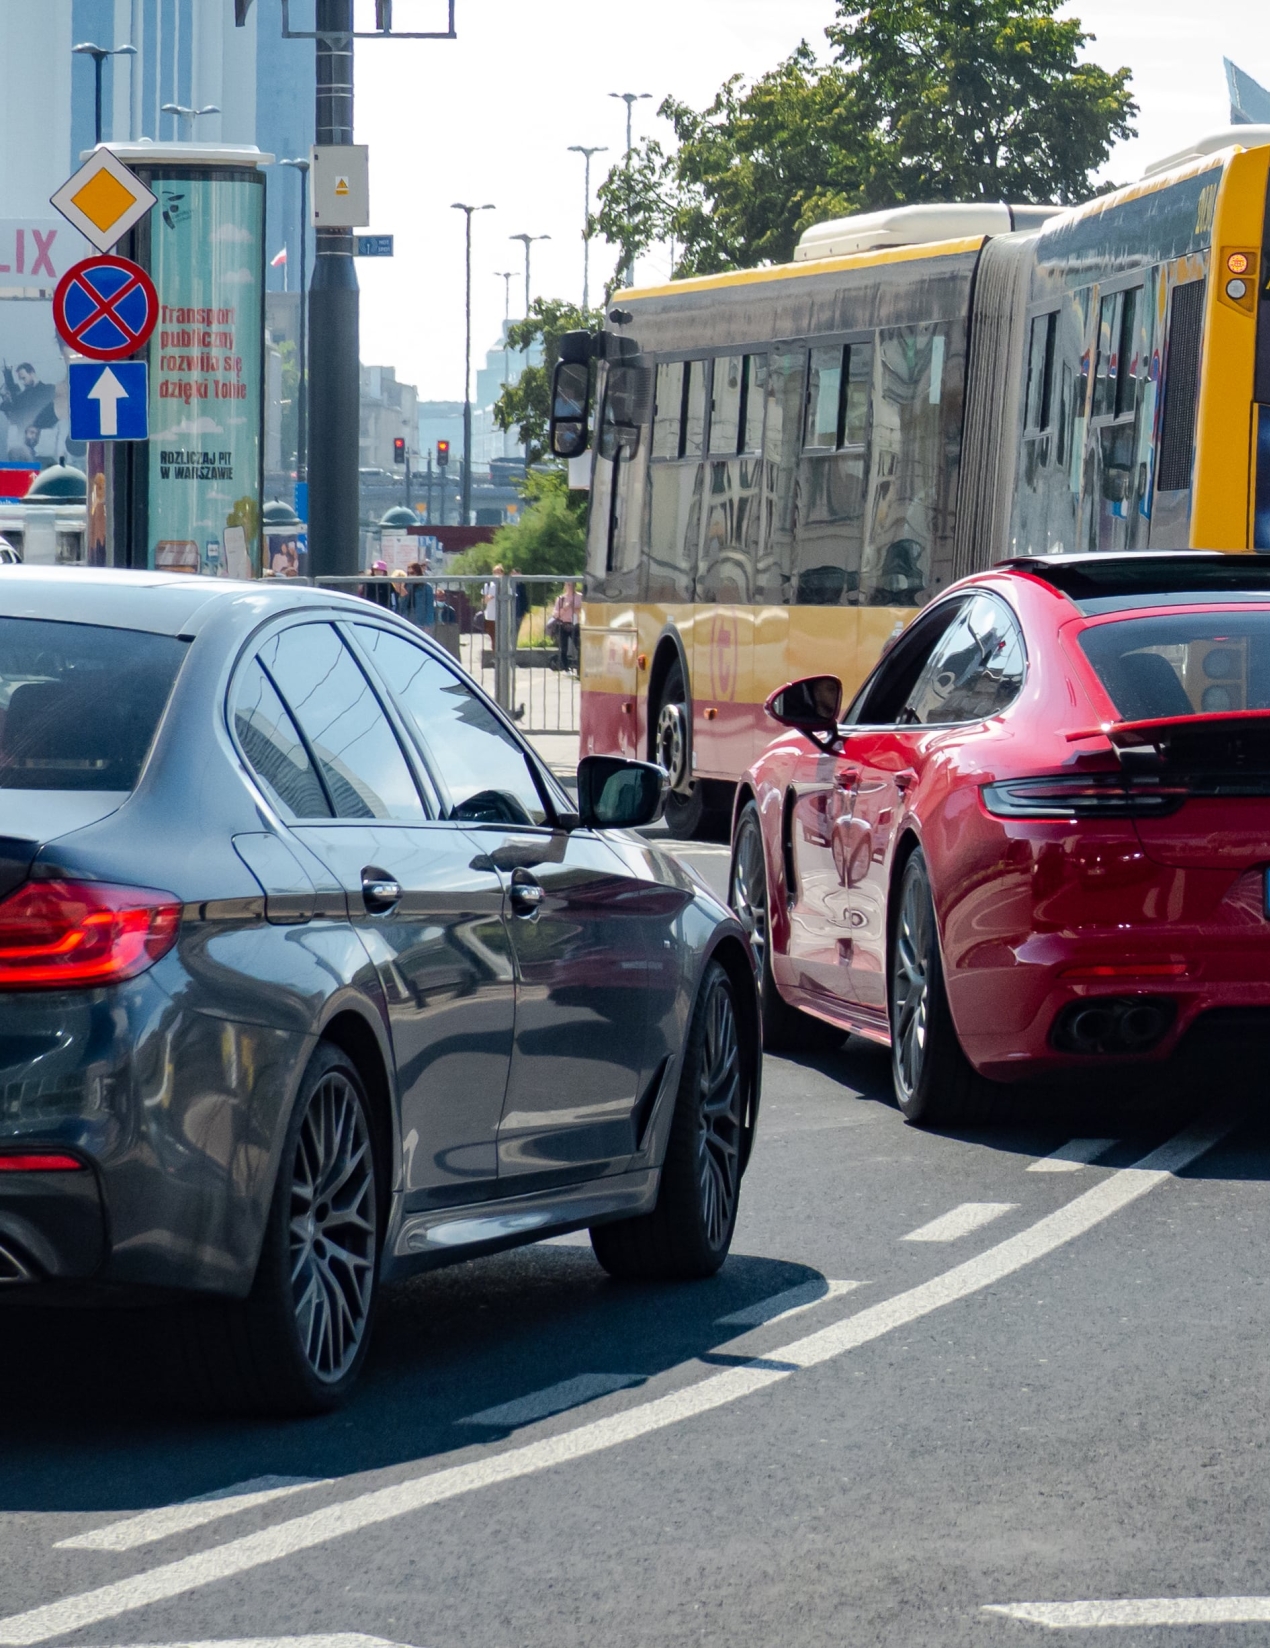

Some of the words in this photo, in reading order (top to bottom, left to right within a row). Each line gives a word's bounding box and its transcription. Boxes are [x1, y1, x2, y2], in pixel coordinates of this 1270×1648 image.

[161, 304, 236, 326] Transport
[160, 328, 234, 350] publiczny
[160, 352, 220, 373] rozwija
[223, 352, 243, 379] się
[159, 378, 209, 405] dzięki
[213, 379, 247, 399] Tobie
[160, 450, 216, 465] ROZLICZAJ
[218, 451, 232, 465] PIT
[160, 466, 170, 479] W
[174, 466, 233, 480] WARSZAWIE
